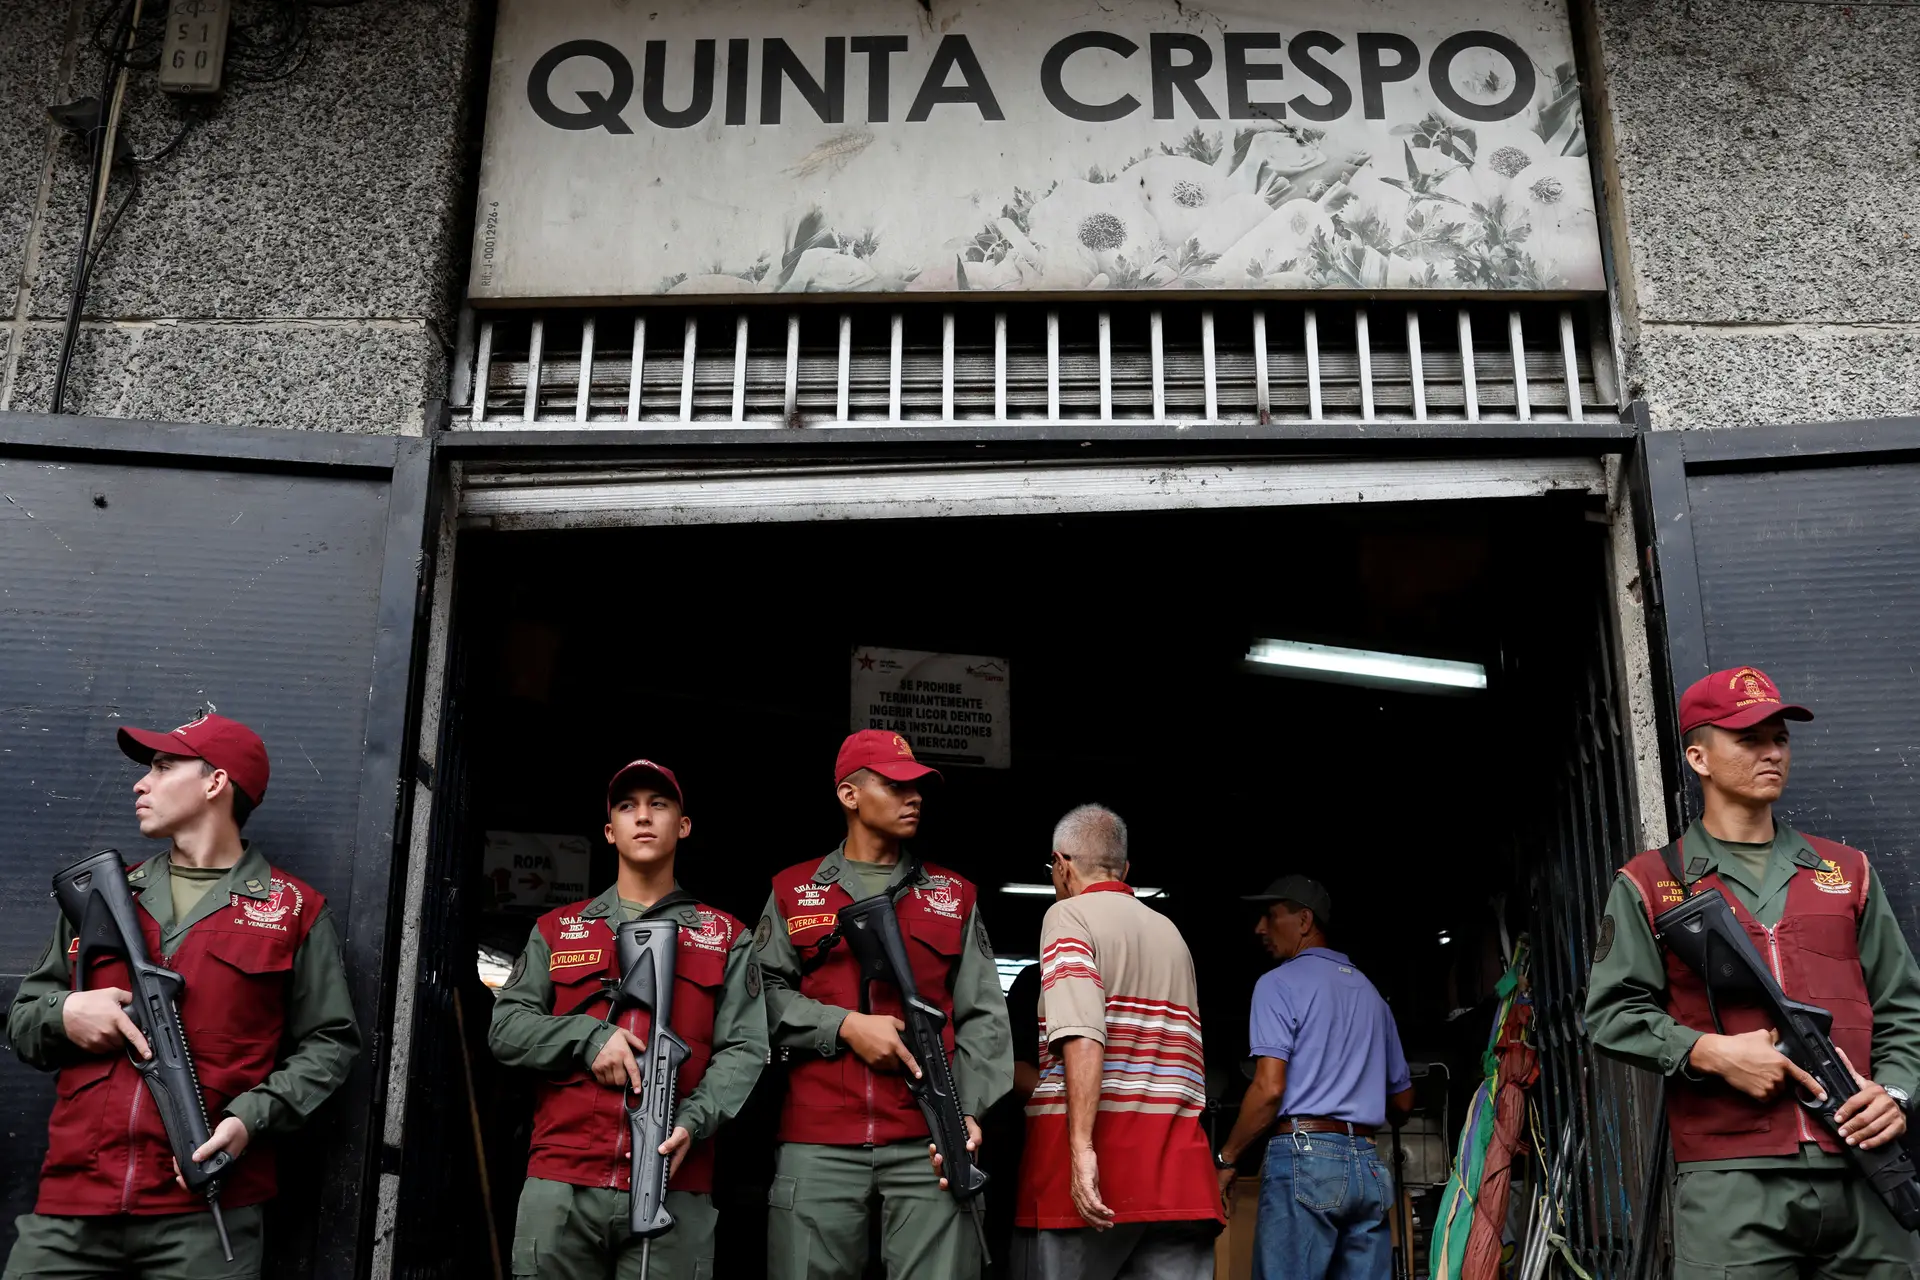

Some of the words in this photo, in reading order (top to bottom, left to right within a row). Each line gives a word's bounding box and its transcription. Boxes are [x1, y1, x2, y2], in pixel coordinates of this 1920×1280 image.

[172, 49, 207, 69] 60
[527, 33, 1006, 135] QUINTA
[1040, 30, 1536, 123] CRESPO
[483, 201, 499, 269] J-00012926-6
[900, 680, 913, 691] SE
[916, 681, 962, 694] PROHIBE
[879, 692, 982, 709] TERMINANTEMENTE
[870, 705, 913, 718] INGERIR
[916, 708, 947, 720] LICOR
[951, 711, 992, 723] DENTRO
[870, 719, 882, 730] DE
[886, 720, 906, 731] LAS
[909, 722, 992, 738] INSTALACIONES
[917, 737, 968, 749] MERCADO
[514, 855, 551, 869] ROPA
[797, 898, 826, 907] PUEBLO
[932, 909, 963, 920] VENEZUELA
[247, 920, 288, 931] VENEZUELA
[569, 924, 584, 932] DEL
[560, 930, 590, 940] PUEBLO
[695, 943, 727, 954] VENEZUELA
